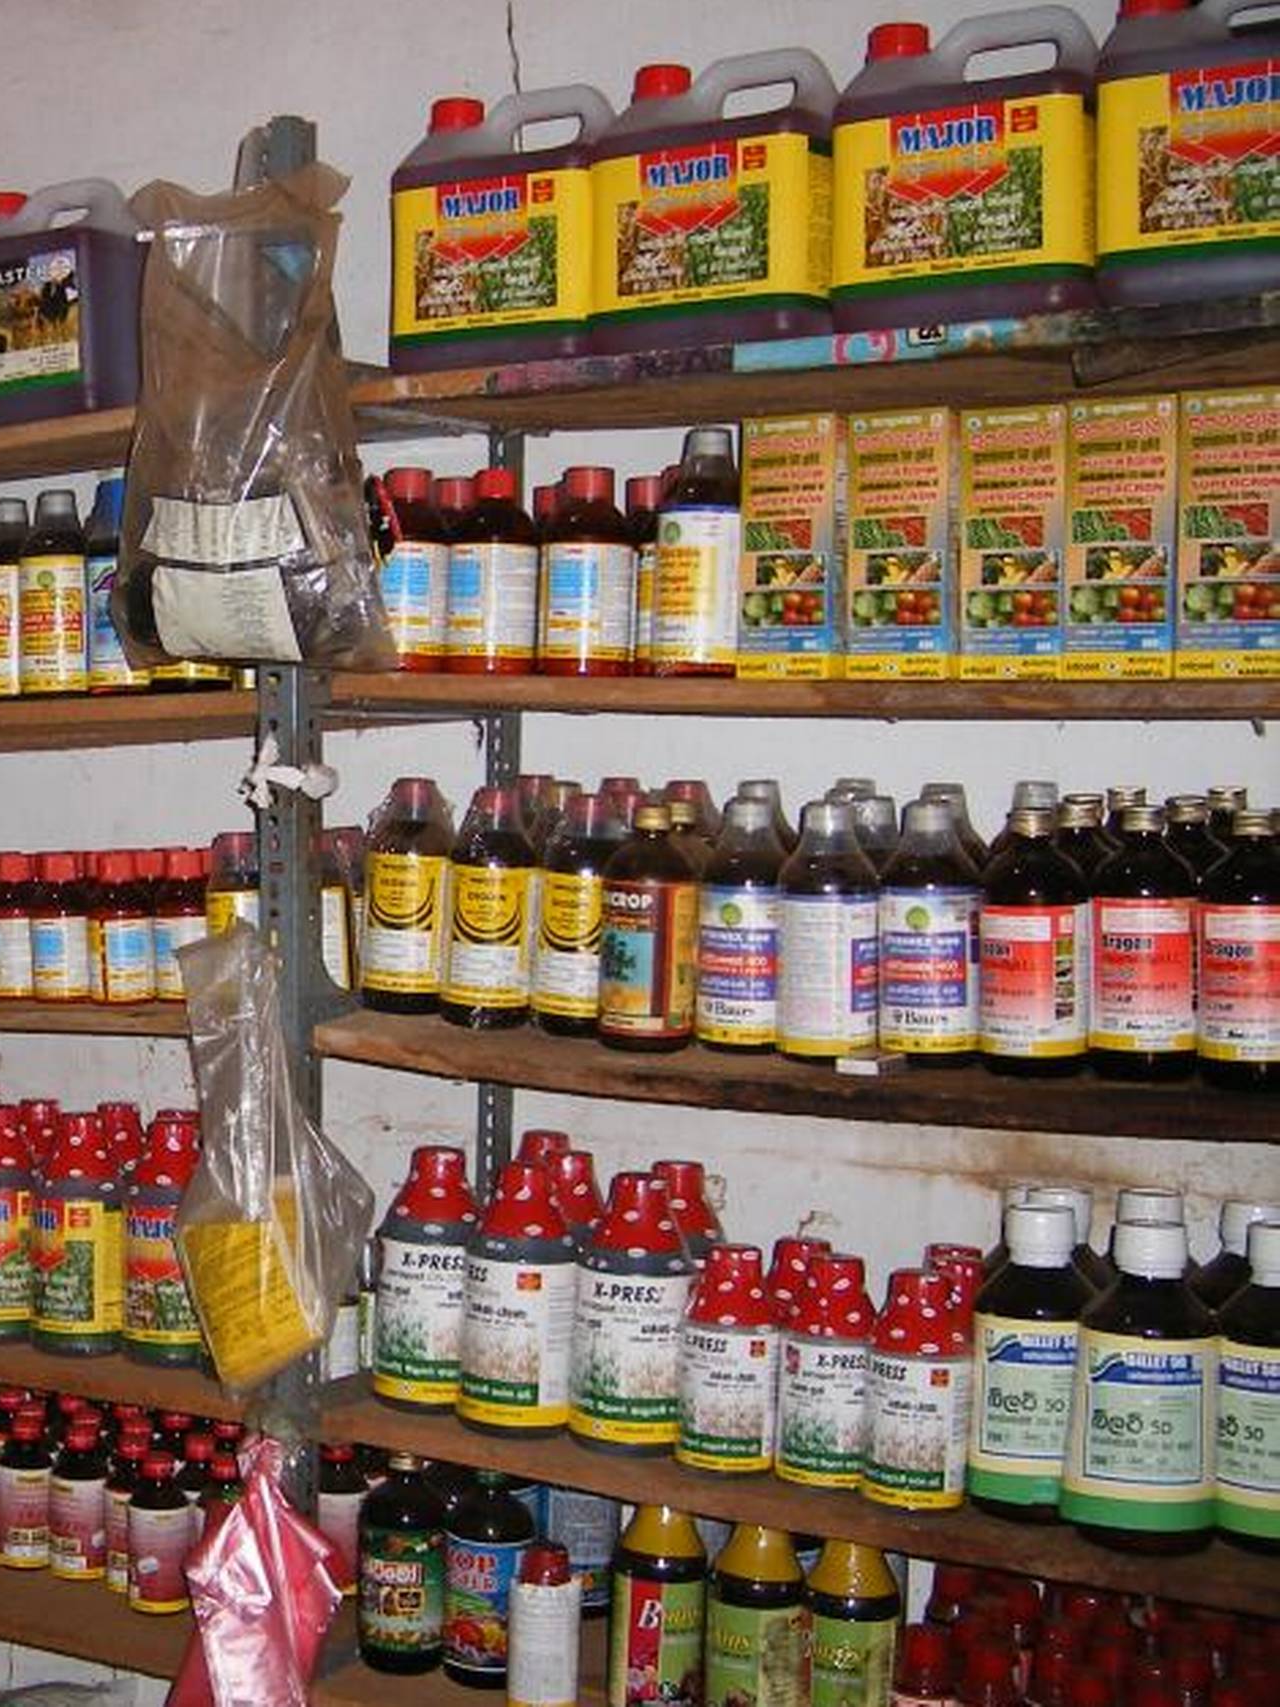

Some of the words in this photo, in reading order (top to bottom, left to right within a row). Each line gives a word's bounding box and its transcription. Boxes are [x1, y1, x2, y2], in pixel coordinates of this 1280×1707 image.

[897, 116, 995, 155] MAJOR
[647, 154, 730, 188] MAJOR
[442, 187, 519, 218] MAJOR
[401, 1253, 465, 1273] X-PRES
[816, 1353, 870, 1372] X-PRES
[1149, 1420, 1173, 1437] 50
[1242, 1425, 1266, 1442] 50
